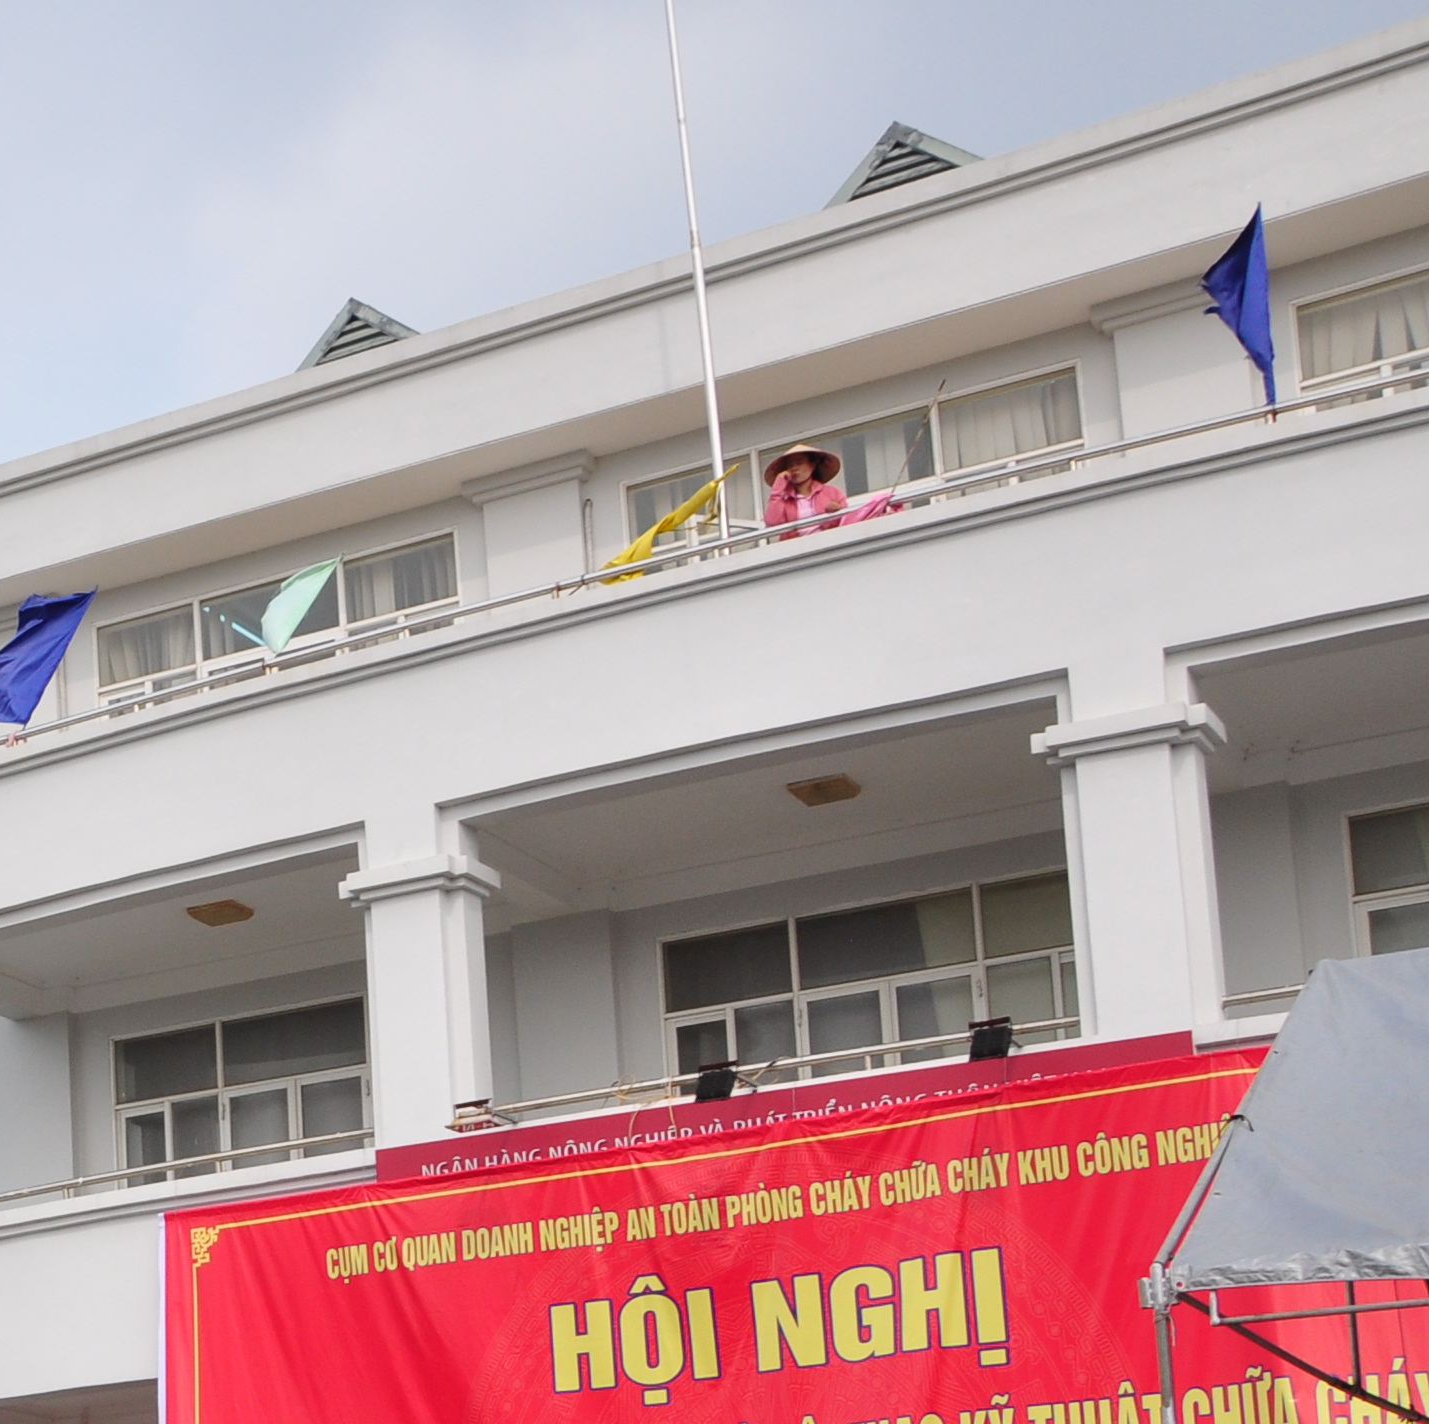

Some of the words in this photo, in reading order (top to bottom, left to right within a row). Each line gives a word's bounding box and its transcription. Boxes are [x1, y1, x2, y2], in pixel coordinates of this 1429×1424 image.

[325, 1242, 369, 1285] CỤM
[372, 1235, 398, 1272] CƠ
[401, 1230, 457, 1272] QUAN
[460, 1220, 535, 1262] DOANH
[538, 1206, 620, 1253] NGHIỆP
[625, 1210, 657, 1243] AN
[660, 1192, 721, 1237] TOÀN
[724, 1182, 804, 1229] PHÒNG
[809, 1174, 872, 1218] CHÁY
[878, 1159, 942, 1208] CHỮA
[946, 1147, 1010, 1195] CHÁY
[1017, 1144, 1071, 1186] KHU
[1074, 1130, 1147, 1177] CÔNG
[549, 1273, 723, 1407] HỘI
[749, 1246, 1011, 1372] NGHỊ
